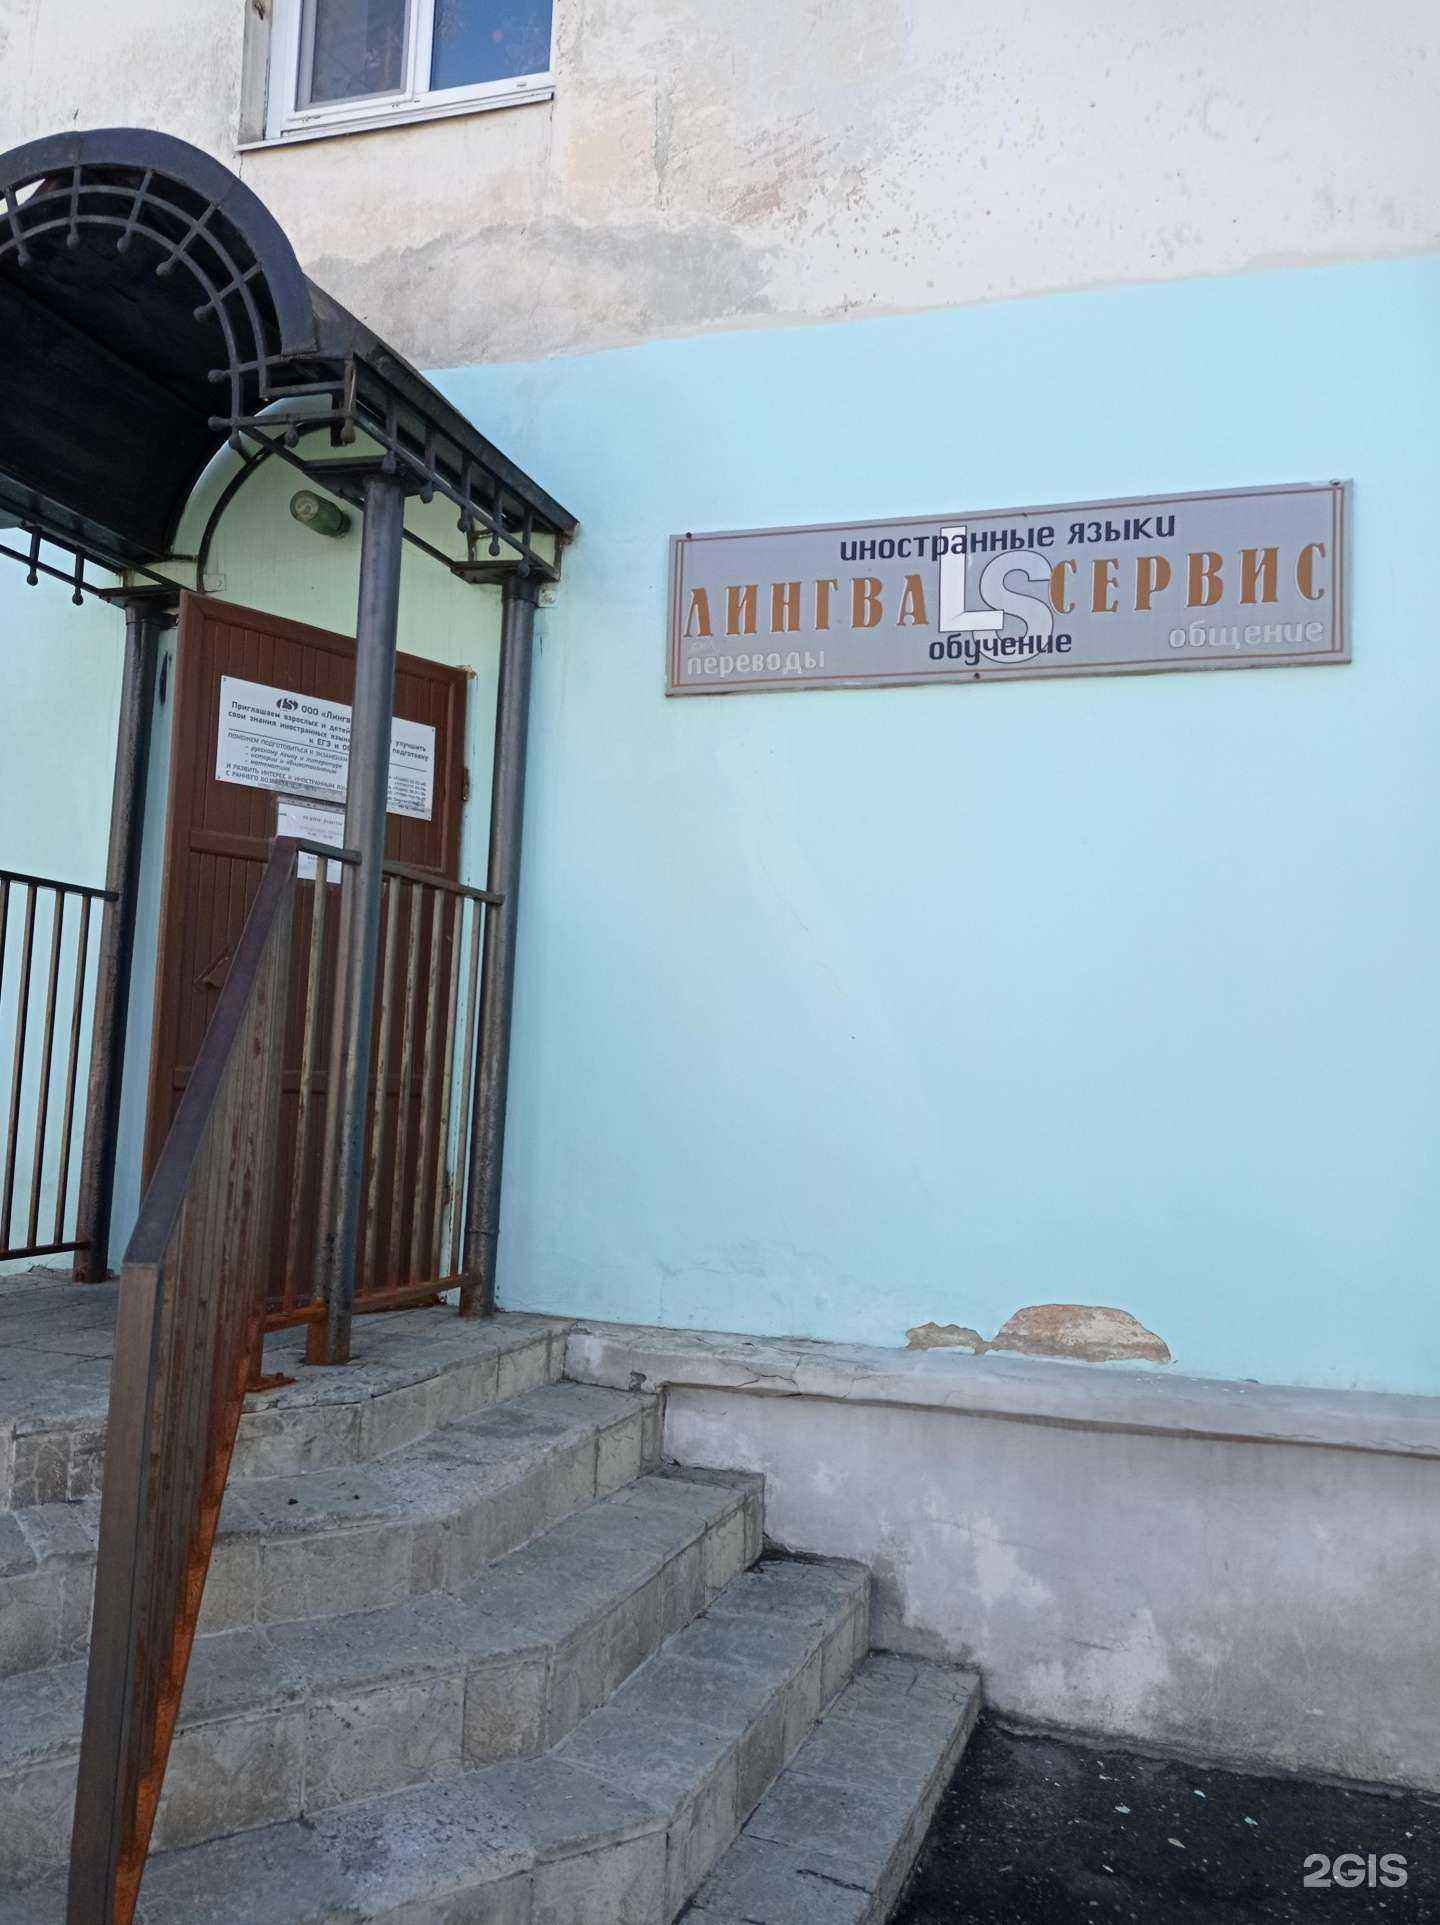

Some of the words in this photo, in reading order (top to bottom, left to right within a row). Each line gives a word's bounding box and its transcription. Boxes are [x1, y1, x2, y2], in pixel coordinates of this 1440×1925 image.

[840, 526, 1055, 561] иностранные
[1067, 514, 1176, 545] языки
[1049, 541, 1326, 616] СЕРВИС
[683, 573, 930, 638] ЛИНГВА
[928, 632, 1073, 666] обучение
[1168, 620, 1325, 651] общение
[687, 650, 825, 680] переводы
